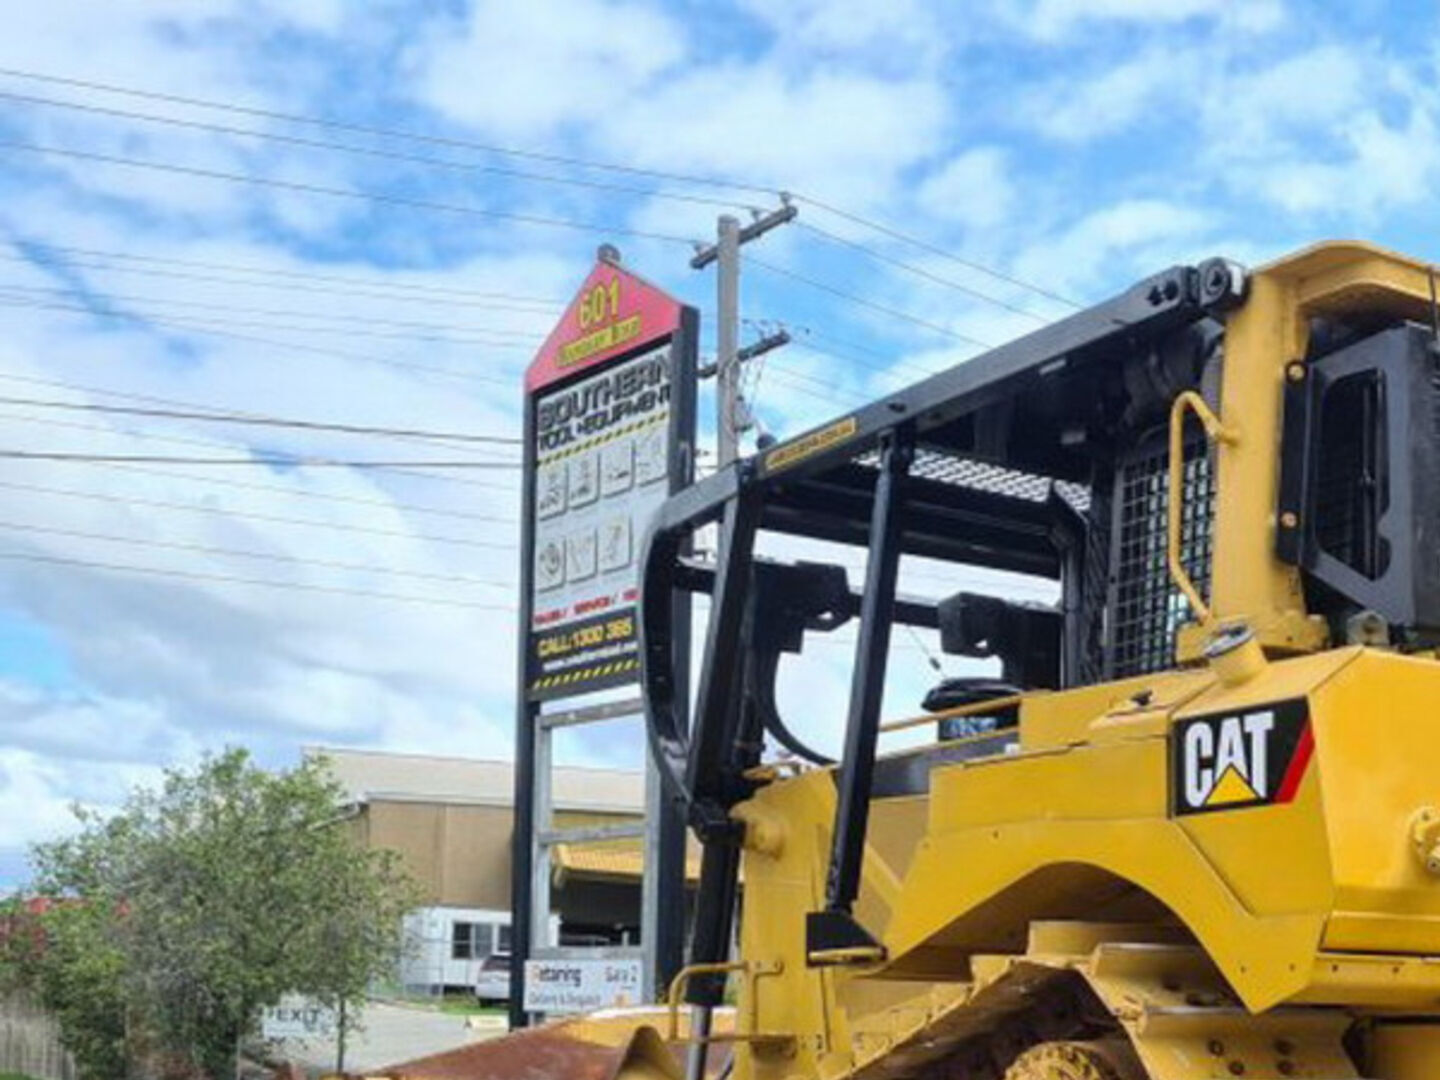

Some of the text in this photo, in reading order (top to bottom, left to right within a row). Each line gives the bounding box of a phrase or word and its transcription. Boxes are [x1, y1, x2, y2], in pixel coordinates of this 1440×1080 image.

[579, 275, 620, 331] 601
[538, 354, 671, 430] SOUTHERN
[1185, 710, 1274, 807] CAT
[276, 1008, 321, 1025] EXIT
